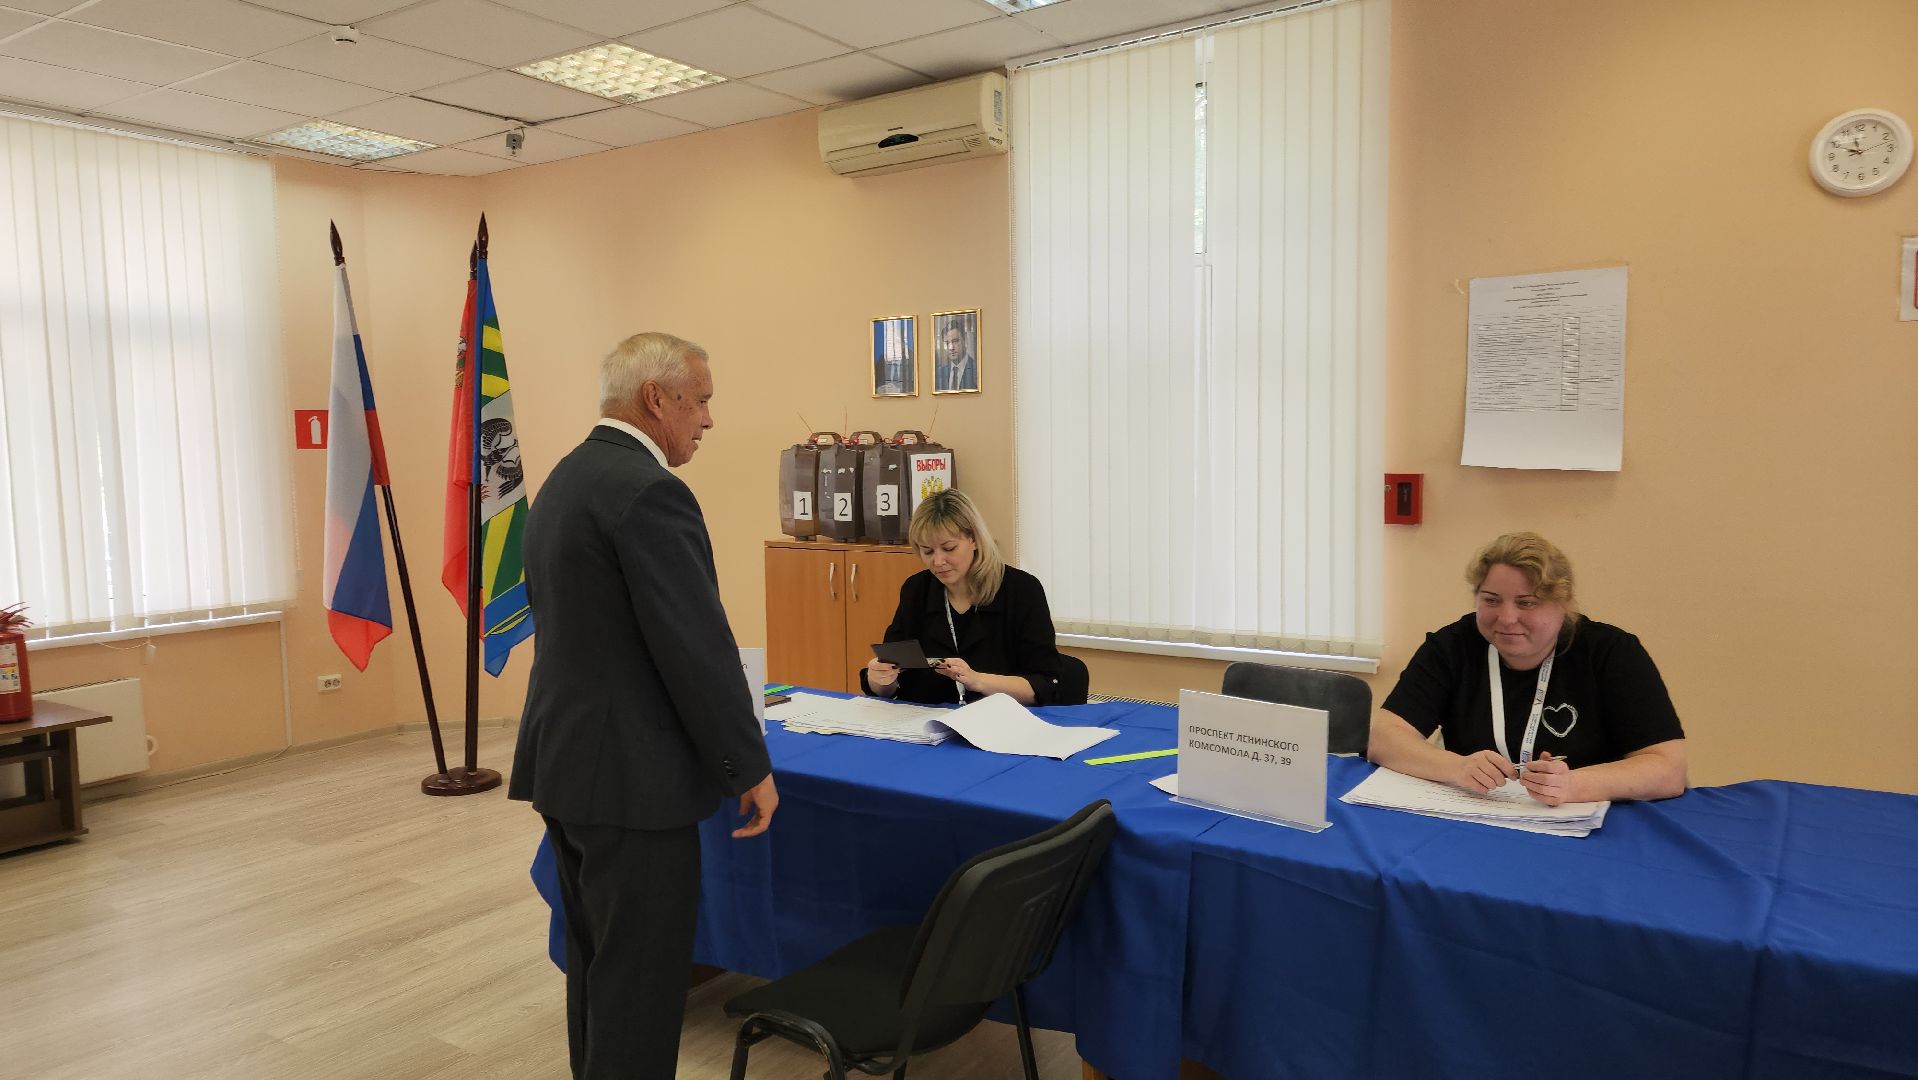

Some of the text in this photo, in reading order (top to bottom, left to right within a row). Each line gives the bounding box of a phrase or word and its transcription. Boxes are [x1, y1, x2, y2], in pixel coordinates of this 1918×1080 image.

[1854, 124, 1865, 132] 12
[1882, 133, 1889, 141] 2
[1887, 144, 1894, 152] 3
[1828, 152, 1835, 161] 9
[1858, 173, 1865, 181] 6
[1872, 167, 1879, 176] 5
[916, 458, 946, 472] ВЫБОРЫ
[799, 497, 808, 516] 1
[838, 497, 848, 517] 2
[880, 493, 891, 512] 3
[1189, 725, 1299, 752] ПРОСПЕКТ ЛЕНИНСКОГО
[1189, 739, 1250, 758] КОМСОМОЛА
[1251, 751, 1262, 762] Д.
[1280, 756, 1292, 766] 39
